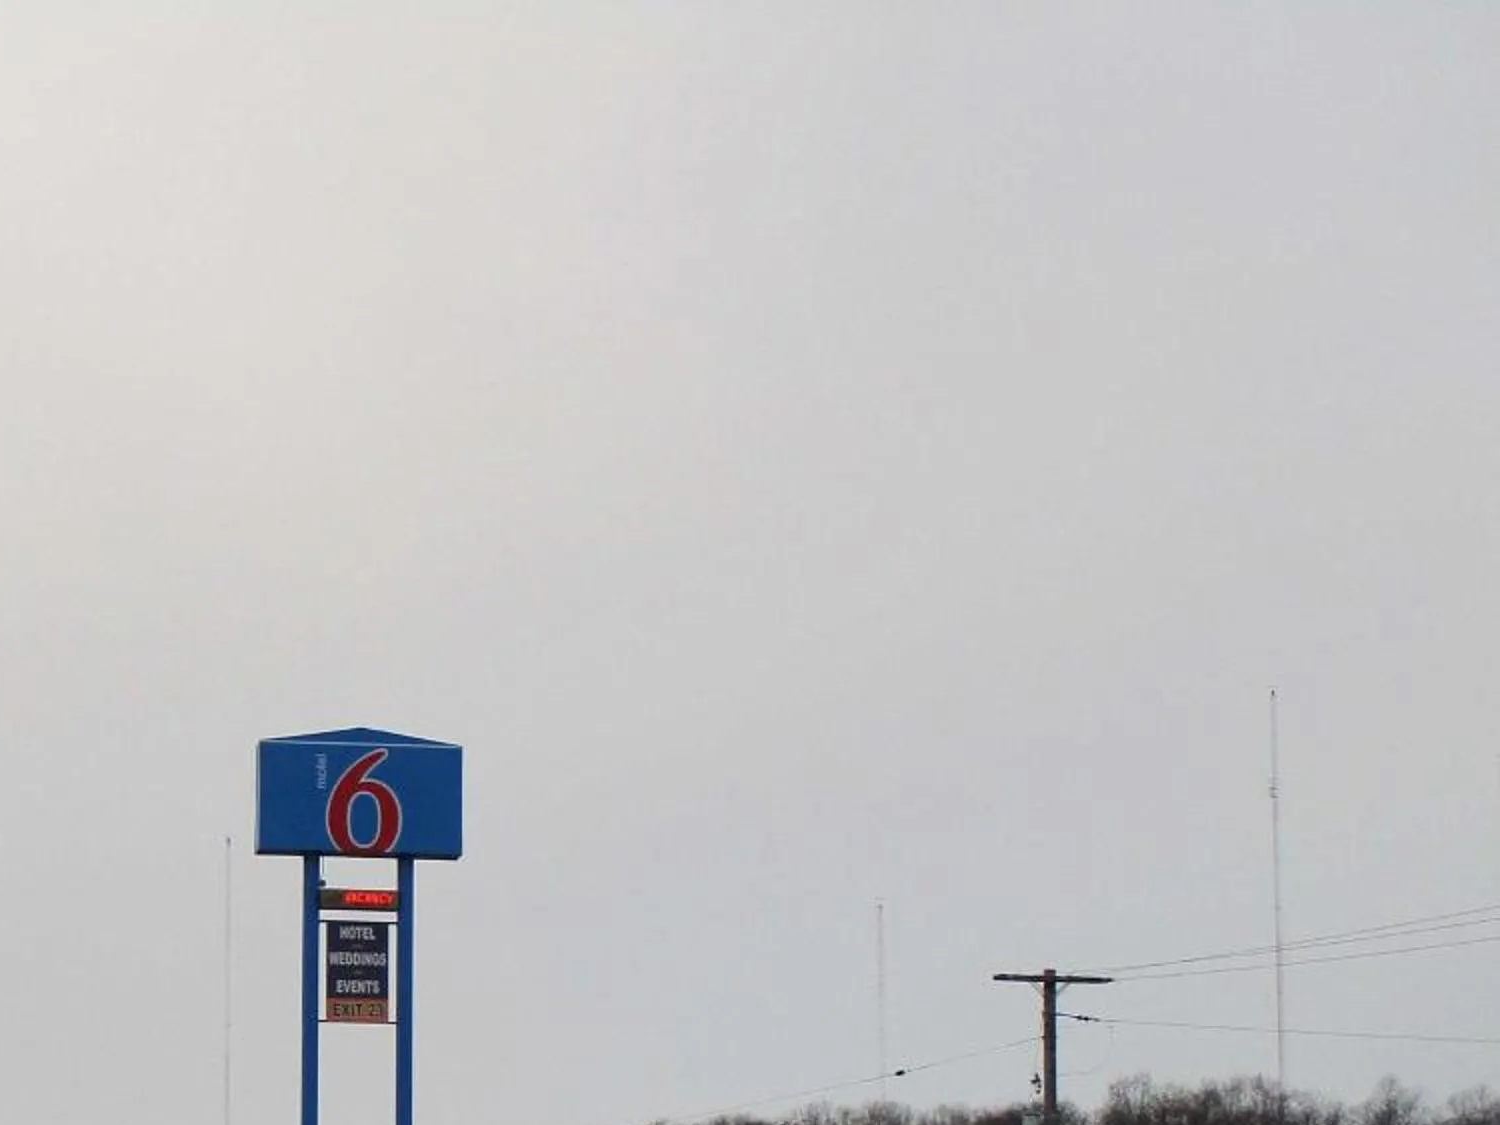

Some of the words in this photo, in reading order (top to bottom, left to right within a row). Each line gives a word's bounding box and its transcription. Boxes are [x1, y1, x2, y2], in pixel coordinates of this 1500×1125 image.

[326, 748, 402, 853] 6
[329, 951, 387, 966] WEDDINGS
[336, 979, 380, 994] EVENTS
[333, 1003, 362, 1017] EXIT
